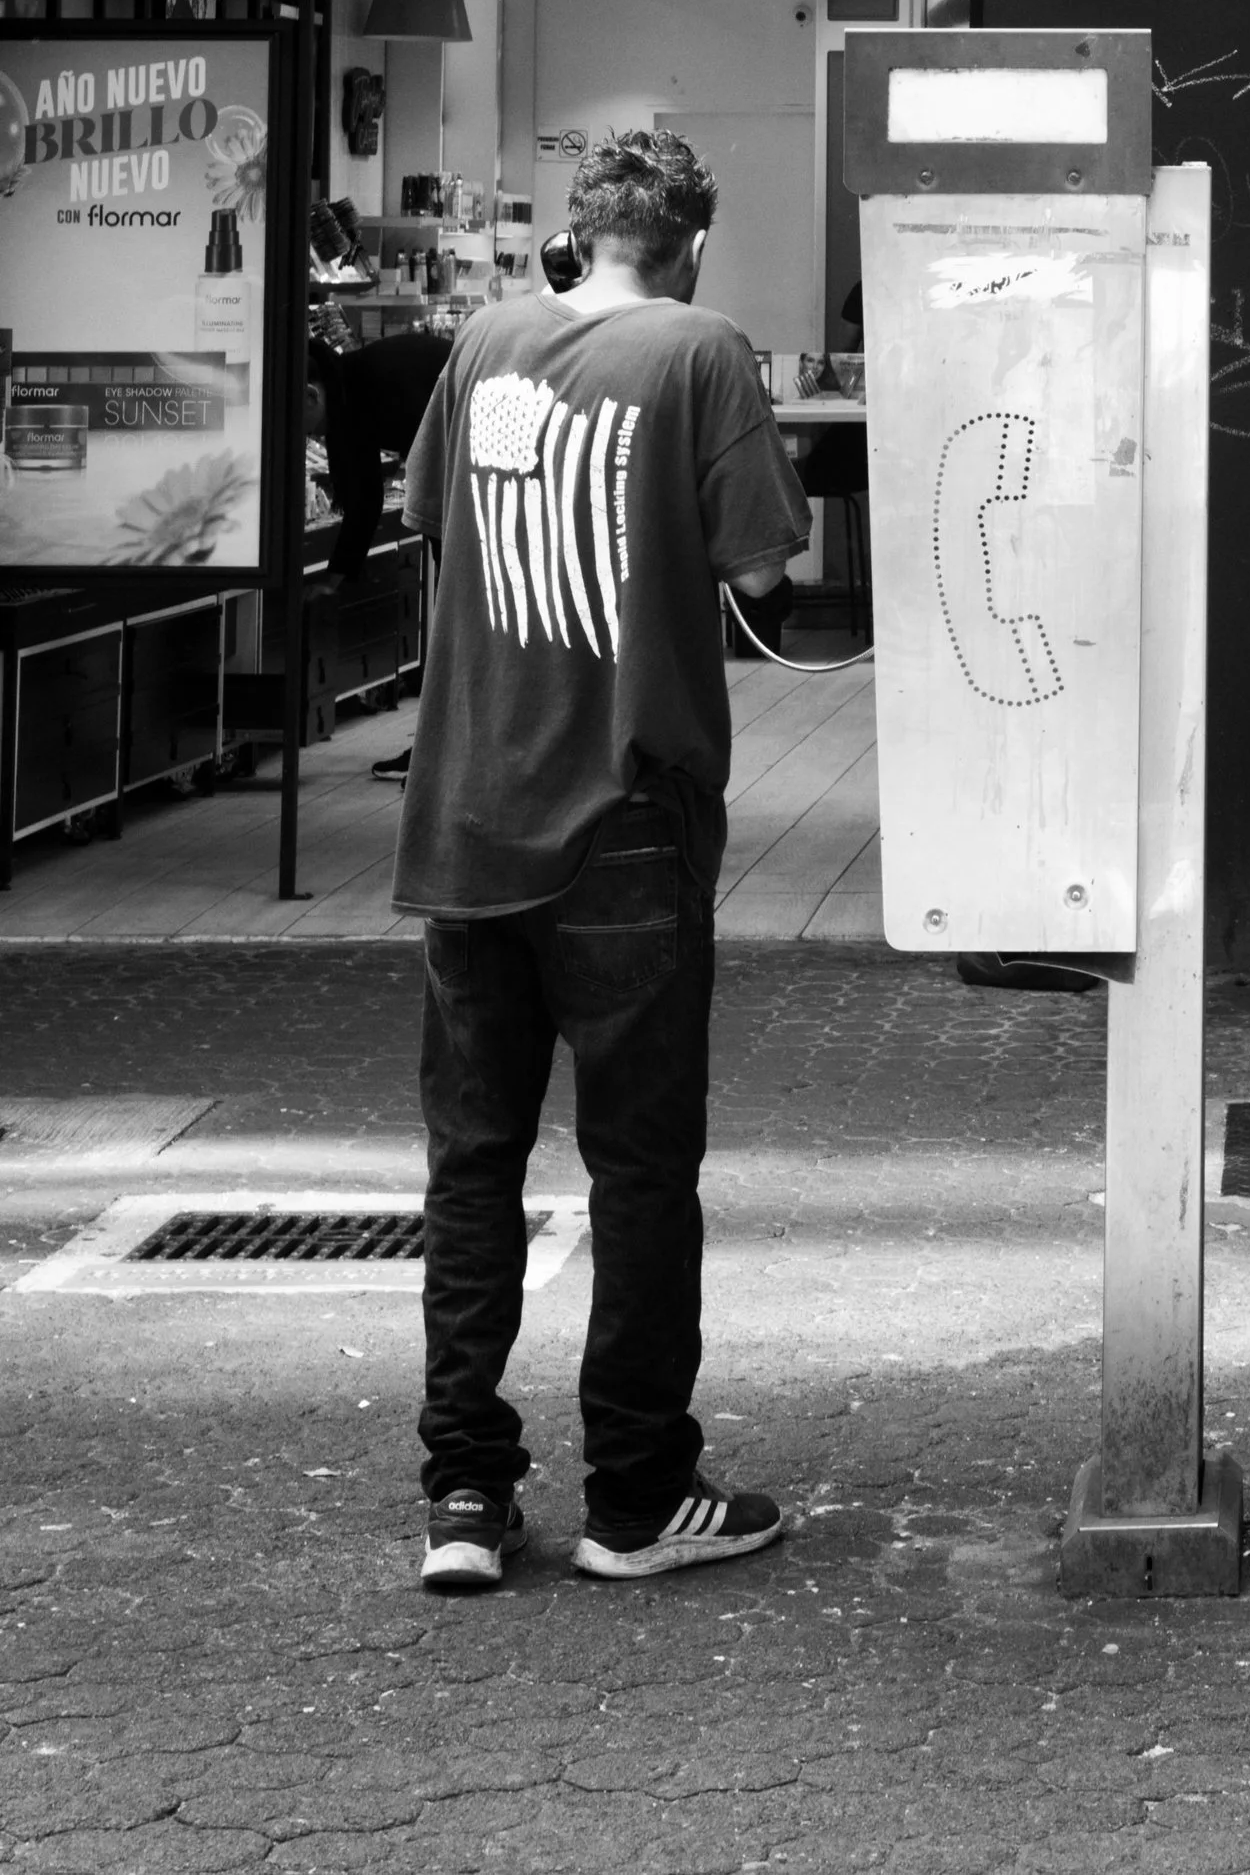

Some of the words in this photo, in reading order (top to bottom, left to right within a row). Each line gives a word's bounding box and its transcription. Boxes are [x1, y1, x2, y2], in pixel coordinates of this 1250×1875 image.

[35, 70, 95, 120] AÑO
[106, 56, 207, 110] NUEVO
[24, 97, 219, 165] BRILLO
[69, 149, 170, 202] NUEVO
[57, 209, 81, 224] CON
[87, 204, 182, 227] flormar
[11, 384, 60, 398] flormar
[105, 386, 122, 398] EYE
[125, 386, 173, 398] SHADOW
[103, 399, 212, 426] SUNSET
[27, 430, 66, 443] flormar
[614, 405, 641, 468] System
[613, 469, 628, 535] Locking
[449, 1501, 484, 1511] adidas
